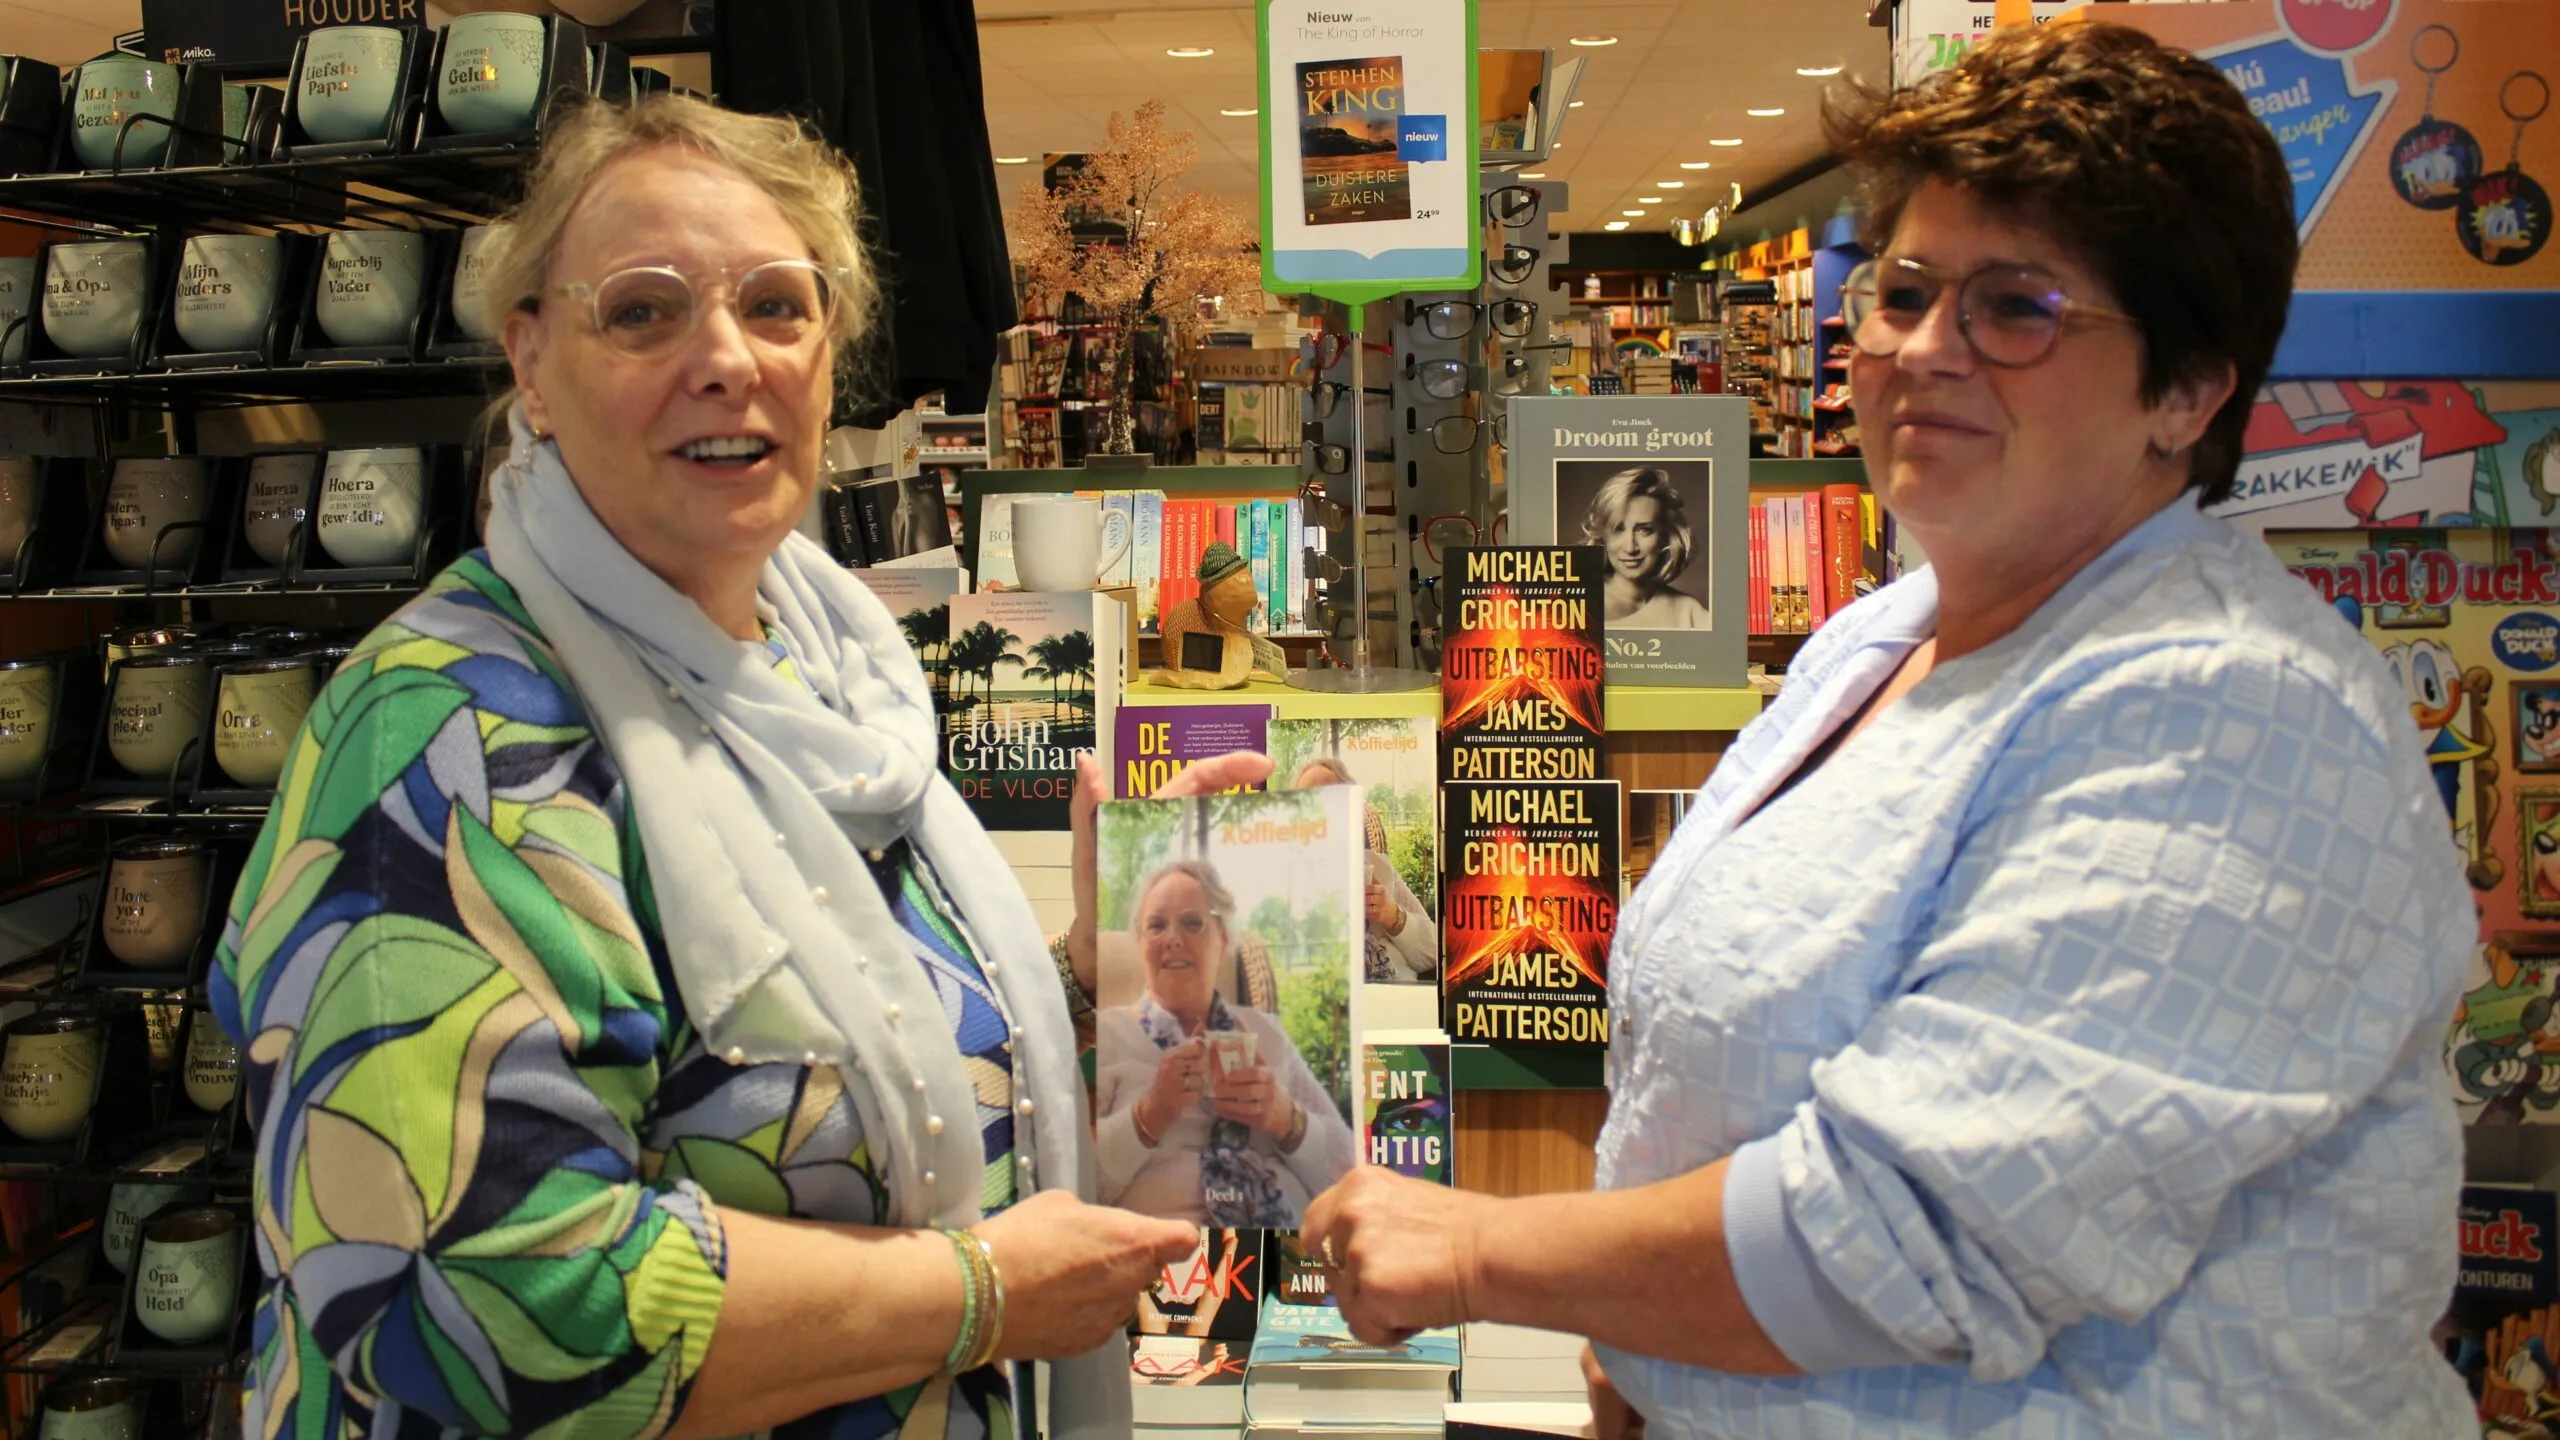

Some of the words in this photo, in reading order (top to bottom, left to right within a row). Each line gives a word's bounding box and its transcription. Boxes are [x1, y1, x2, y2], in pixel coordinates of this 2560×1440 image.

[285, 0, 418, 27] HOUDER
[1307, 11, 1353, 24] Nieuw
[1973, 16, 1995, 28] HE
[1297, 27, 1322, 40] The
[1327, 27, 1358, 42] King
[1362, 26, 1379, 39] of
[1380, 26, 1424, 39] Horror
[305, 62, 358, 81] Liefste
[1305, 66, 1395, 88] STEPHEN
[308, 80, 349, 98] Papa
[2252, 77, 2313, 118] eau!
[1305, 85, 1399, 117] KING
[1405, 132, 1439, 142] nieuw
[1316, 169, 1397, 188] DUISTERE
[1329, 190, 1385, 207] ZAKEN
[327, 256, 383, 271] Superblij
[185, 264, 219, 283] Mijn
[62, 280, 73, 292] &
[76, 279, 111, 297] Opa
[177, 278, 233, 298] Ouders
[328, 279, 371, 294] Vader
[1203, 364, 1280, 376] RAINBOW
[1612, 419, 1628, 427] Eva
[1629, 417, 1653, 427] Jinek
[1553, 428, 1639, 448] Droom
[1645, 427, 1714, 452] groot
[252, 482, 299, 498] Mama
[328, 477, 375, 493] Hoera
[322, 509, 386, 529] geweldig
[865, 502, 874, 521] Tara
[868, 521, 878, 543] Kant
[1468, 550, 1580, 584] MICHAEL
[2287, 550, 2411, 607] nald
[2424, 549, 2560, 607] Duck
[1461, 588, 1501, 596] BEDENKER
[1524, 587, 1562, 595] JURASSIC
[1565, 587, 1587, 595] PARK
[1461, 599, 1586, 631] CRICHTON
[1604, 637, 1644, 657] No.
[1647, 638, 1662, 657] 2
[1450, 647, 1598, 681] UITBARSTING
[1630, 662, 1645, 670] van
[1646, 661, 1697, 670] voorbeelden
[222, 709, 262, 729] Oma
[1480, 700, 1567, 731] JAMES
[965, 707, 1052, 751] John
[1139, 722, 1172, 756] DE
[1347, 736, 1419, 752] Koffietijd
[1464, 735, 1517, 743] INTERNATIONALE
[1520, 735, 1584, 743] BESTSELLERAUTEUR
[1453, 747, 1595, 779] PATTERSON
[963, 778, 993, 799] DE
[1003, 778, 1076, 799] VLOE
[1471, 789, 1593, 824] MICHAEL
[1221, 818, 1328, 846] Koffietijd
[1464, 830, 1507, 838] BEDENKER
[1532, 830, 1573, 838] JURASSIC
[1577, 830, 1599, 838] PARK
[1464, 842, 1599, 877] CRICHTON
[116, 901, 146, 919] you
[1452, 895, 1611, 933] UITBARSTING
[1484, 953, 1578, 988] JAMES
[1468, 990, 1526, 999] INTERNATIONALE
[1528, 991, 1597, 1001] BESTSELLERAUTEUR
[1456, 1003, 1608, 1043] PATTERSON
[1363, 1070, 1427, 1100] ENT
[1371, 1135, 1441, 1166] HTIG
[1205, 1186, 1236, 1203] Deel
[113, 1209, 140, 1226] Thu
[2458, 1210, 2542, 1262] uck
[1300, 1260, 1312, 1268] Een
[148, 1269, 179, 1288] Opa
[1161, 1252, 1256, 1301] AAK
[2456, 1271, 2533, 1289] ONTUREN
[146, 1295, 185, 1312] Held
[1273, 1306, 1317, 1317] VAN
